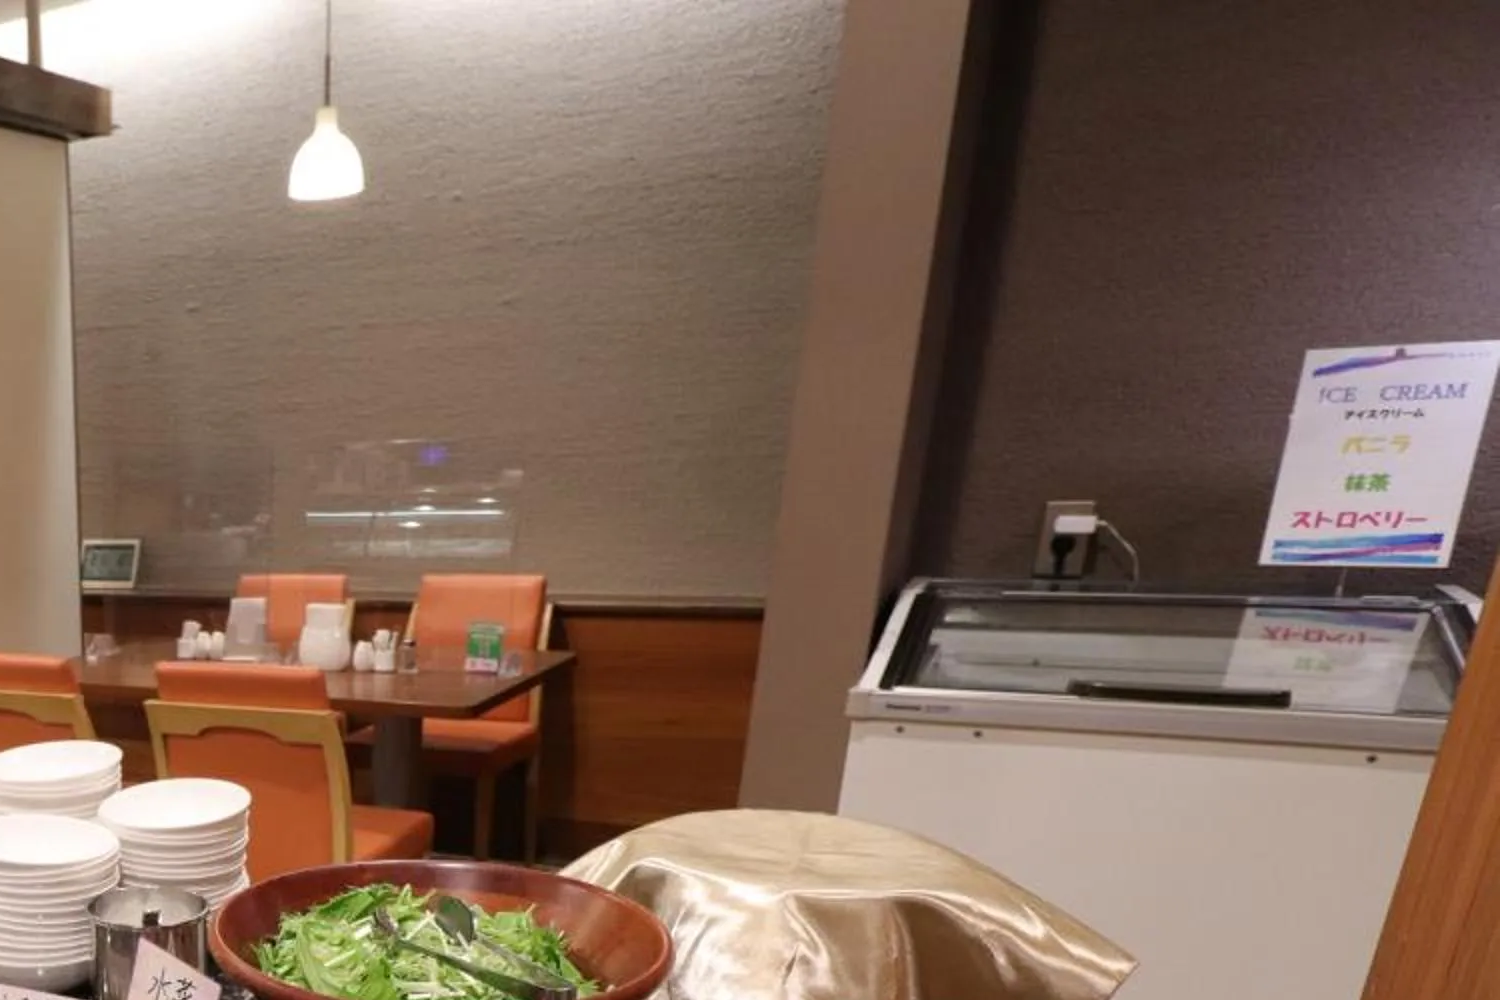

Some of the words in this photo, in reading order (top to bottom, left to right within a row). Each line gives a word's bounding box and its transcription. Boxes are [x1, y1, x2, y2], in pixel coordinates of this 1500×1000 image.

[1318, 386, 1358, 404] ICE
[1379, 382, 1470, 402] CREAM
[1344, 408, 1425, 420] アイスクリーム
[1340, 433, 1412, 455] バニラ
[1344, 472, 1392, 492] 抹茶
[1290, 510, 1429, 529] ストロベリー
